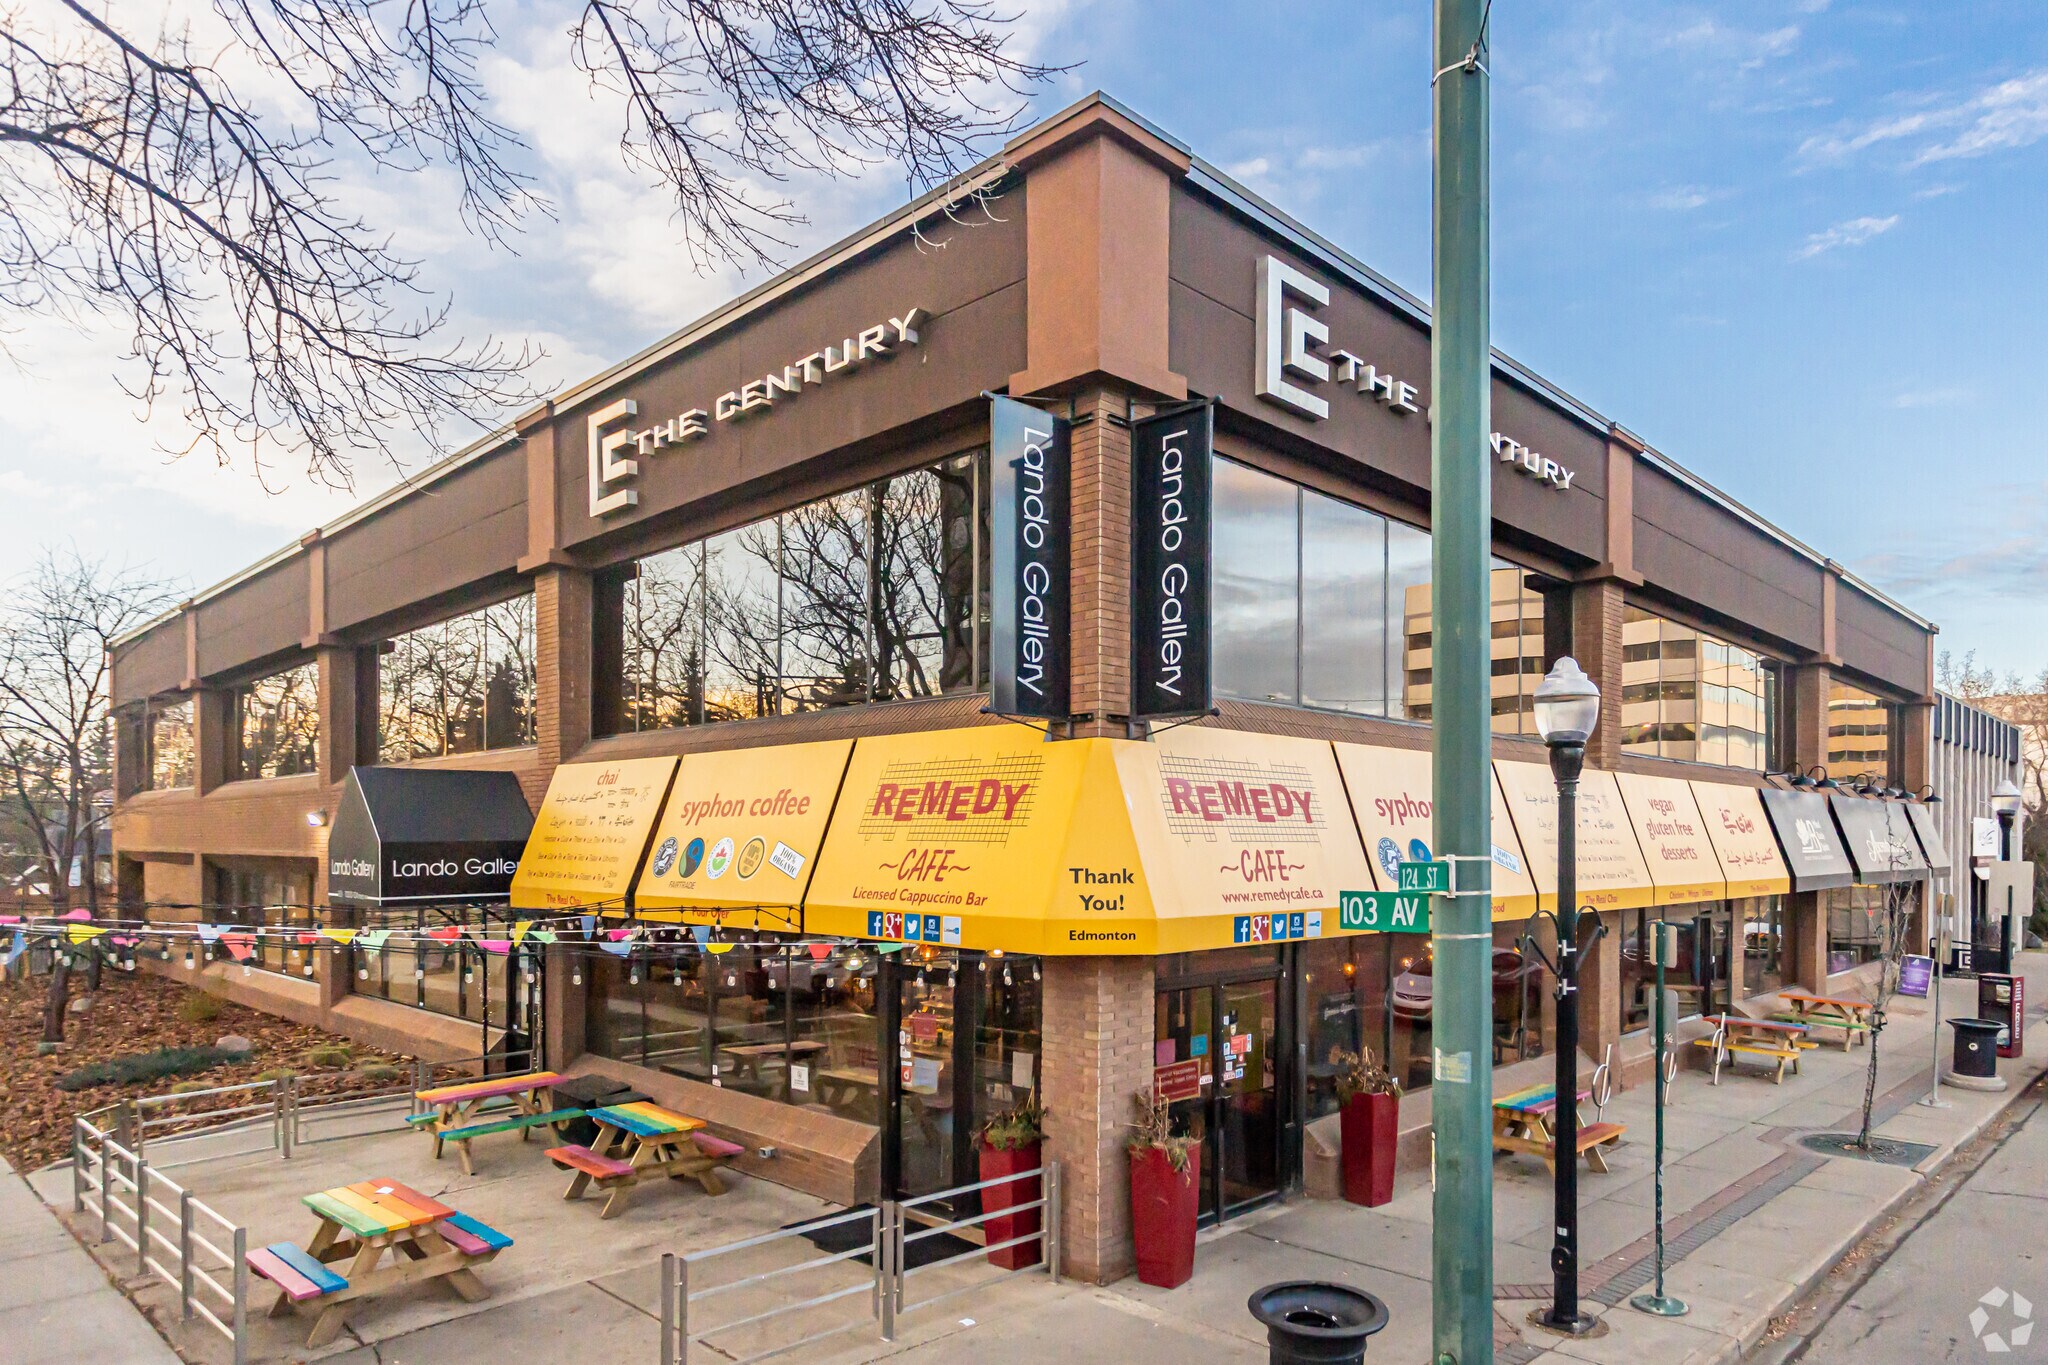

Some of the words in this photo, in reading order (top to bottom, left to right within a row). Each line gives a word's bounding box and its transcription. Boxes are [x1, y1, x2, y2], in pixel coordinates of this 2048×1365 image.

[633, 409, 707, 455] THE
[716, 308, 930, 421] CENTURY
[1329, 350, 1418, 413] THE
[1023, 427, 1049, 549] Lando
[1162, 430, 1187, 551] Lando
[1017, 562, 1049, 696] Gallery
[1156, 563, 1188, 696] Gallery
[597, 769, 620, 785] chai
[681, 793, 745, 826] syphon
[750, 788, 811, 816] coffee
[872, 779, 1030, 822] REMEDY
[1166, 777, 1313, 823] REMEDY
[1648, 799, 1675, 816] vegan
[1646, 818, 1676, 840] gluten
[1676, 819, 1694, 836] free
[780, 847, 797, 864] 100%
[1661, 843, 1698, 860] desserts
[331, 859, 351, 876] Lando
[351, 859, 374, 880] Gallery
[393, 859, 458, 877] Lando
[464, 858, 521, 875] Galler
[773, 855, 797, 875] ORGANIC
[1069, 868, 1134, 885] Thank
[1402, 868, 1418, 888] 124
[1427, 867, 1437, 888] ST
[546, 894, 556, 903] The
[557, 894, 568, 904] Real
[853, 887, 896, 902] Licensed
[899, 889, 963, 908] Cappuccino
[967, 893, 987, 907] Bar
[1079, 895, 1124, 912] You!
[1222, 887, 1324, 906] www.remedycafe.ca
[1585, 895, 1595, 905] The
[692, 906, 707, 918] Pour
[711, 907, 729, 919] Over
[1341, 896, 1378, 925] 103
[1391, 897, 1419, 926] AV
[1069, 929, 1136, 942] Edmonton
